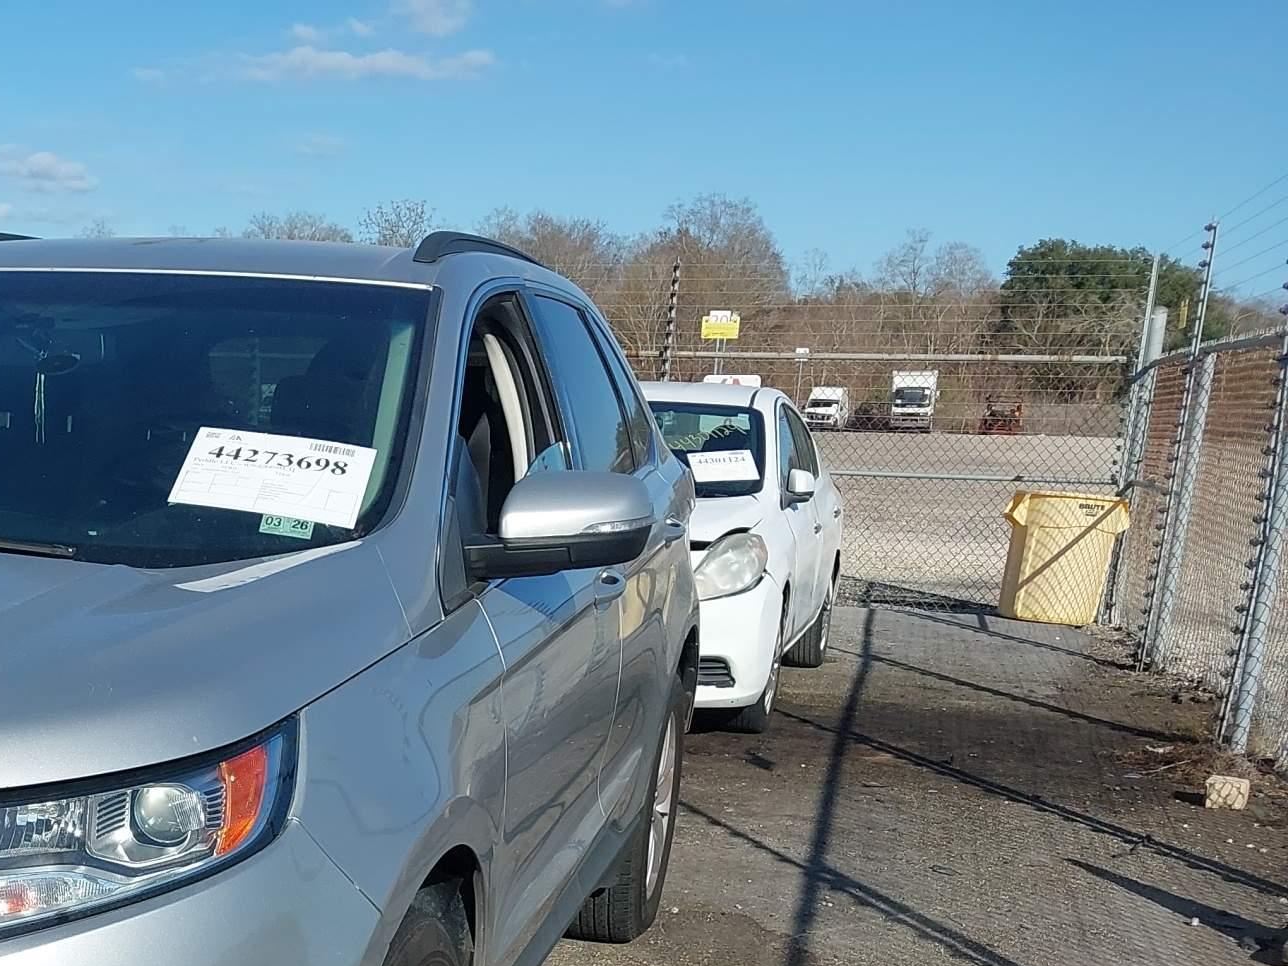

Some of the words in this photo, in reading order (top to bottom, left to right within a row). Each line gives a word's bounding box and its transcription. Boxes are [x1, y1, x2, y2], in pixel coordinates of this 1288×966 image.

[208, 446, 348, 476] 44273698
[697, 456, 746, 465] 44301124
[1079, 503, 1105, 511] BRUTE
[265, 515, 283, 527] 03
[291, 518, 309, 531] 26
